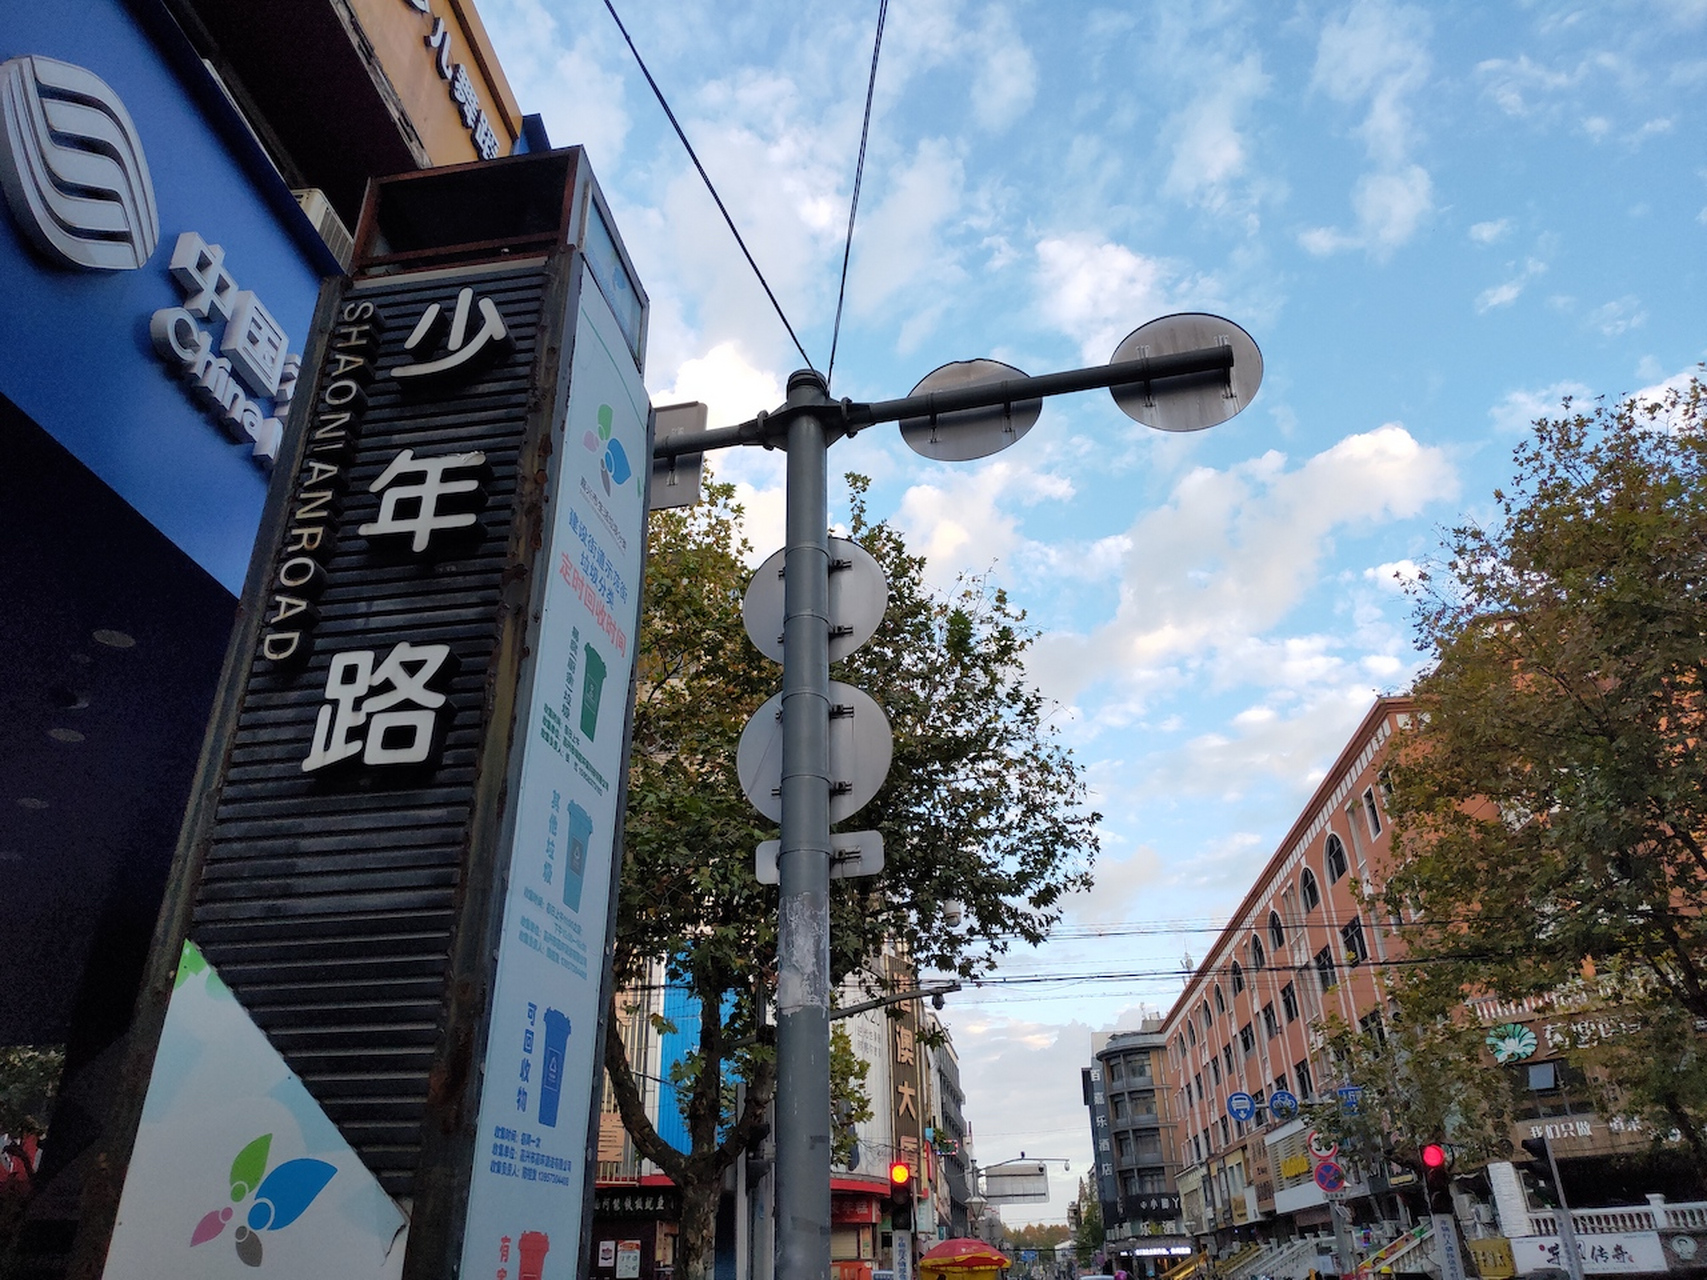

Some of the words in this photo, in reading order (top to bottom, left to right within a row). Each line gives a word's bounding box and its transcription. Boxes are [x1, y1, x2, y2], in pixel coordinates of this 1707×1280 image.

[404, 0, 499, 161] 儿舞蹈
[150, 307, 264, 443] China
[302, 287, 508, 772] 少年路
[580, 551, 614, 610] 垃圾分类
[560, 552, 626, 657] 定时回收时间
[543, 789, 561, 885] 其他垃圾
[517, 1001, 537, 1113] 可回收物
